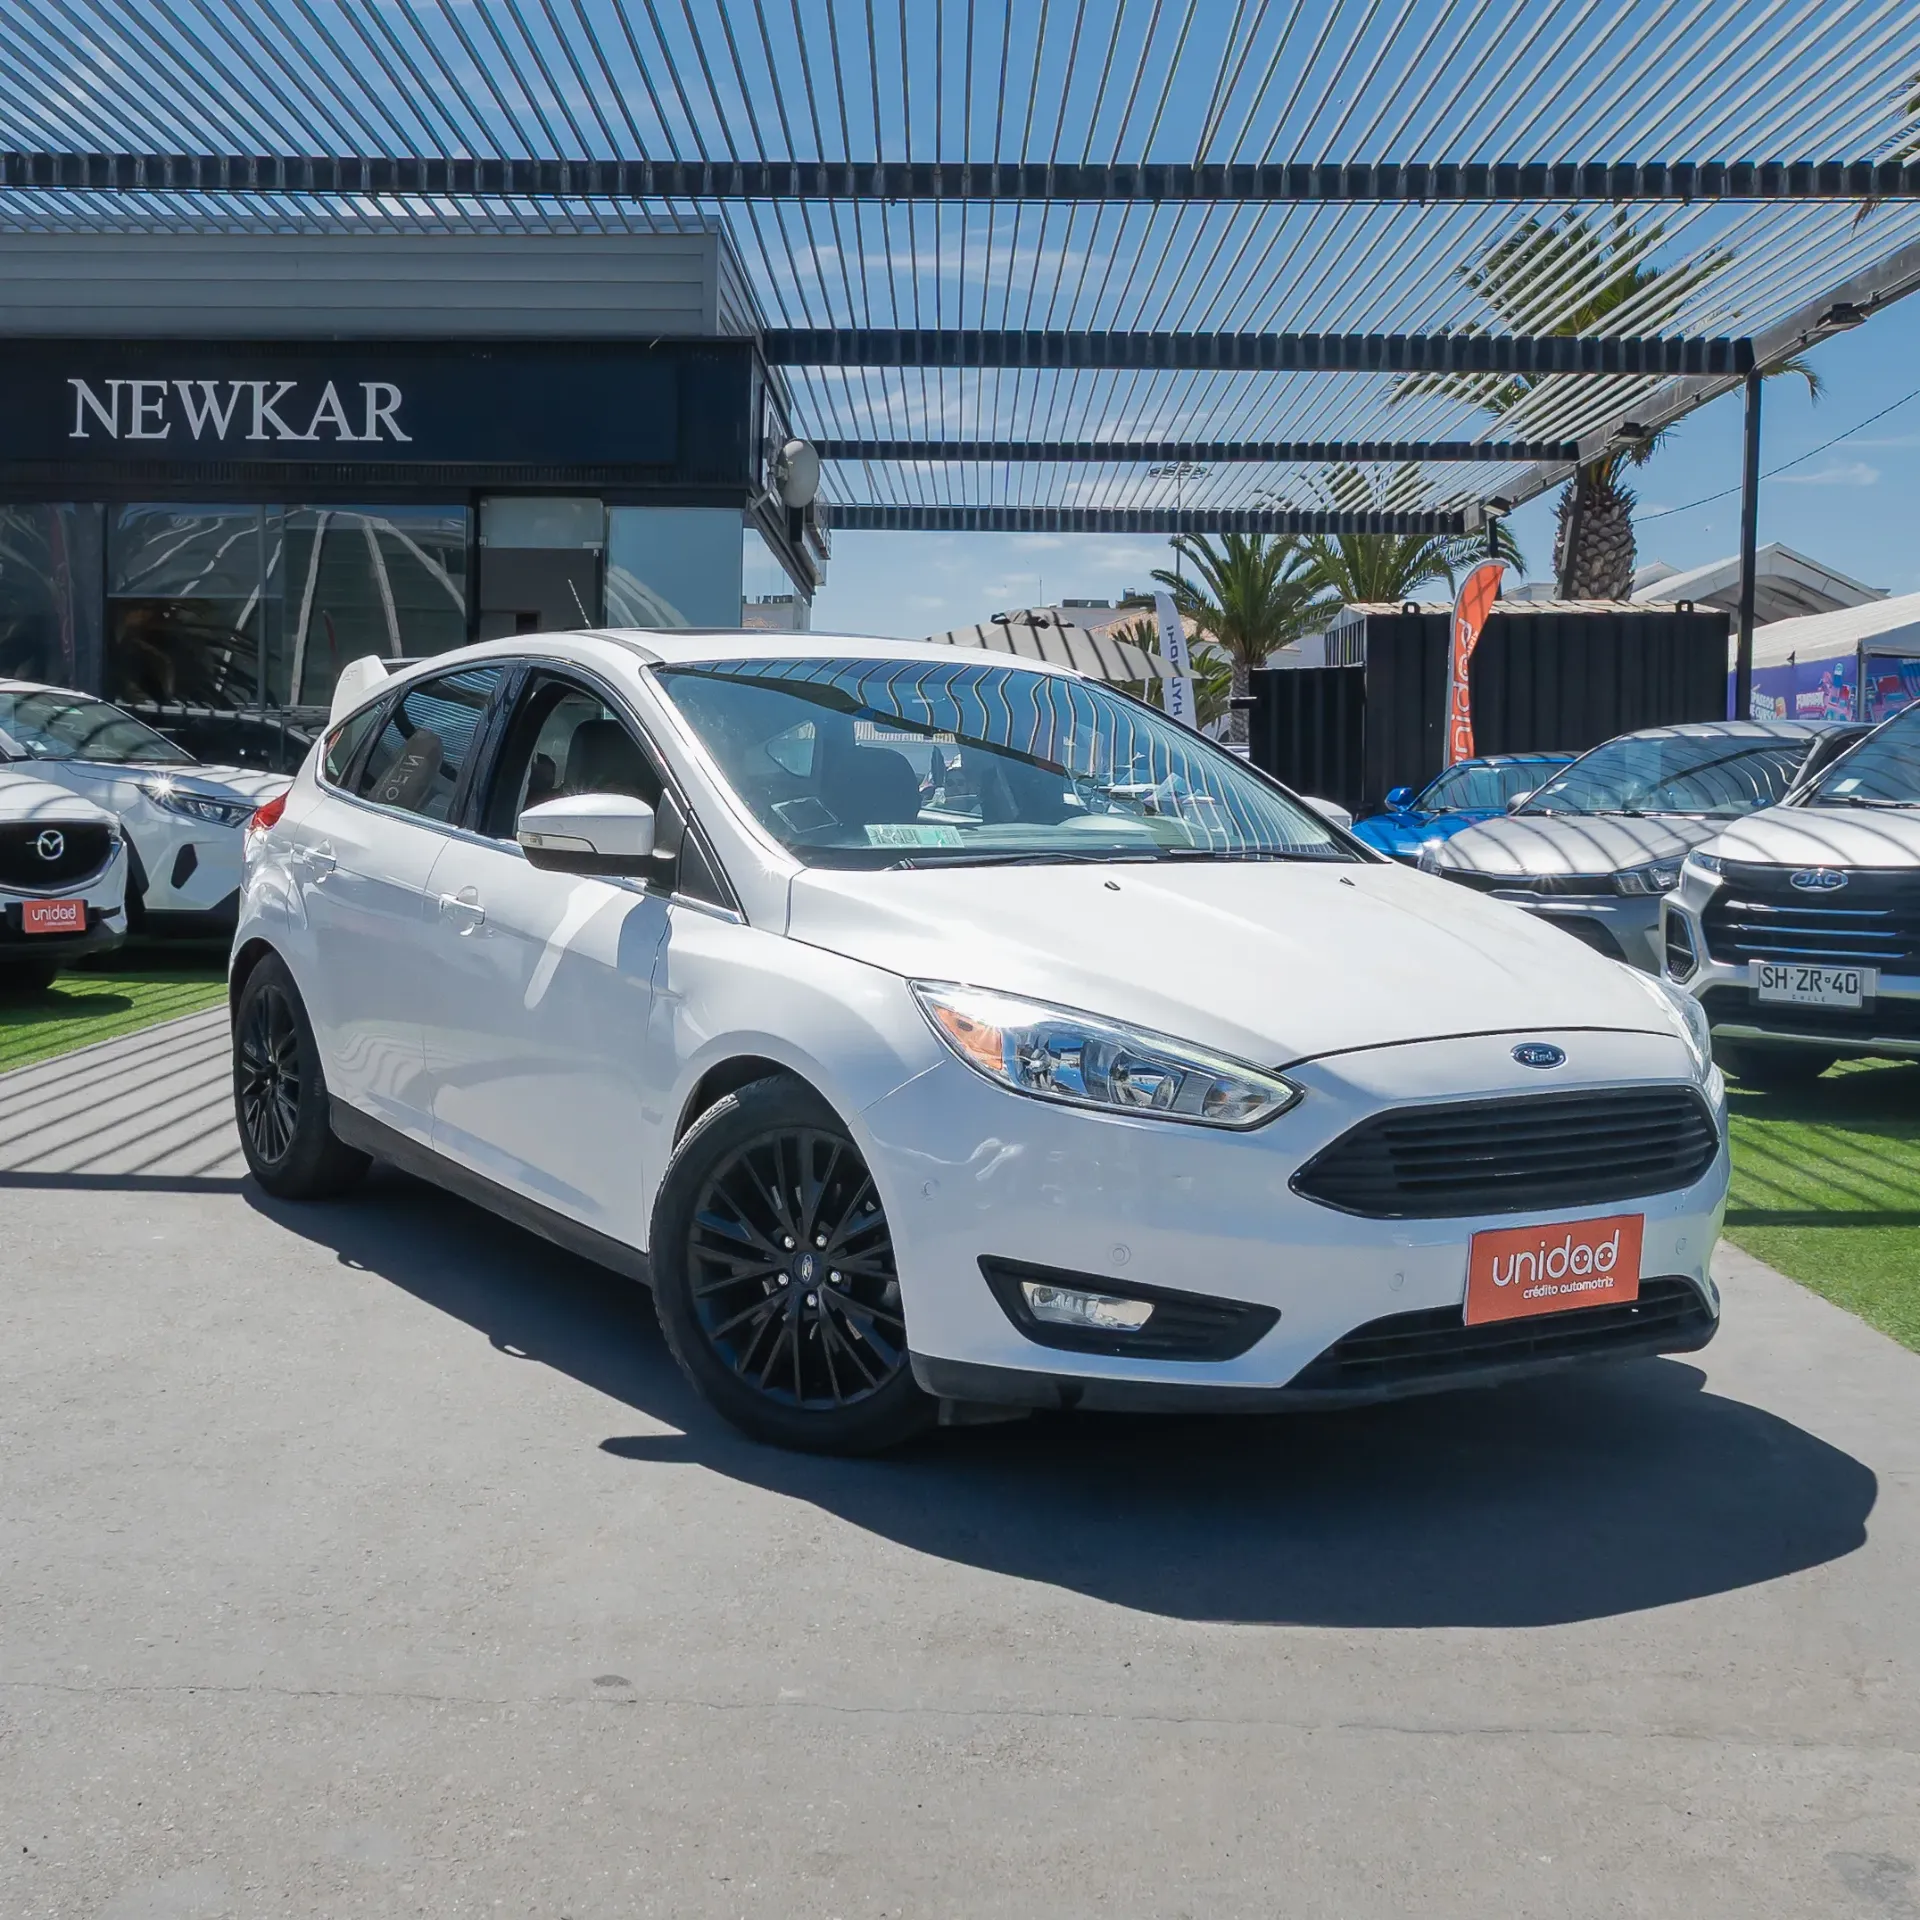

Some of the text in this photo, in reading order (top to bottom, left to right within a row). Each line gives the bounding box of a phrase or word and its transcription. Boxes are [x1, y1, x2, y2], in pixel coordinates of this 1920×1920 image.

[67, 379, 412, 441] NEWKAR
[1452, 618, 1472, 763] nidad
[1796, 873, 1839, 885] JAC
[31, 903, 76, 920] unidad
[1492, 1229, 1620, 1287] unidad
[1523, 1276, 1614, 1299] crédito automotriz
